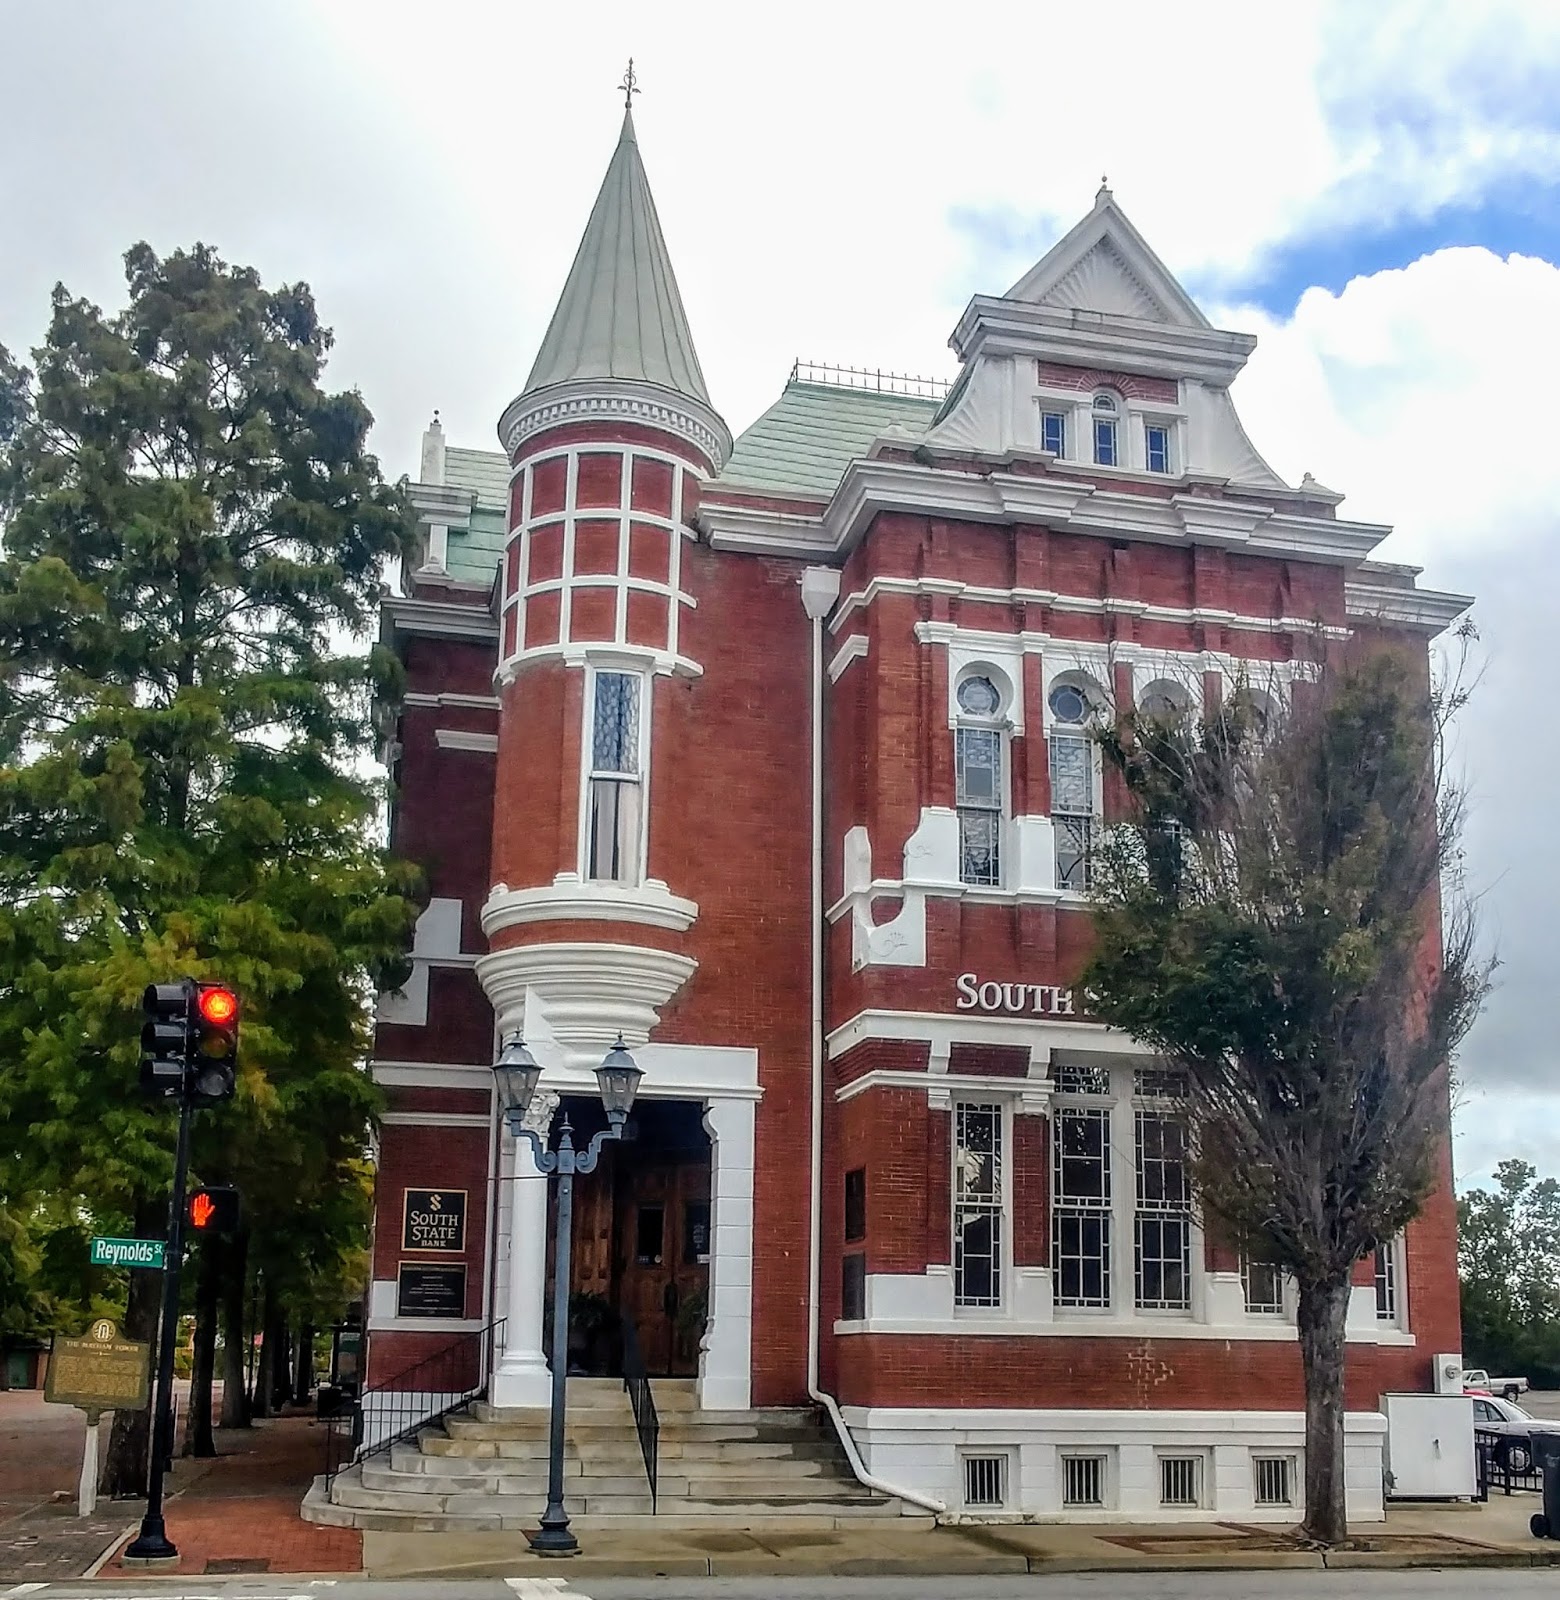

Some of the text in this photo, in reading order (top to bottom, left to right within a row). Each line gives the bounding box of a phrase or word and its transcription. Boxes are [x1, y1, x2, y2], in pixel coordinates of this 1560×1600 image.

[956, 972, 1075, 1015] SOUTH
[410, 1210, 459, 1226] SOUTH
[412, 1226, 456, 1241] STATE
[96, 1240, 153, 1265] Reynolds
